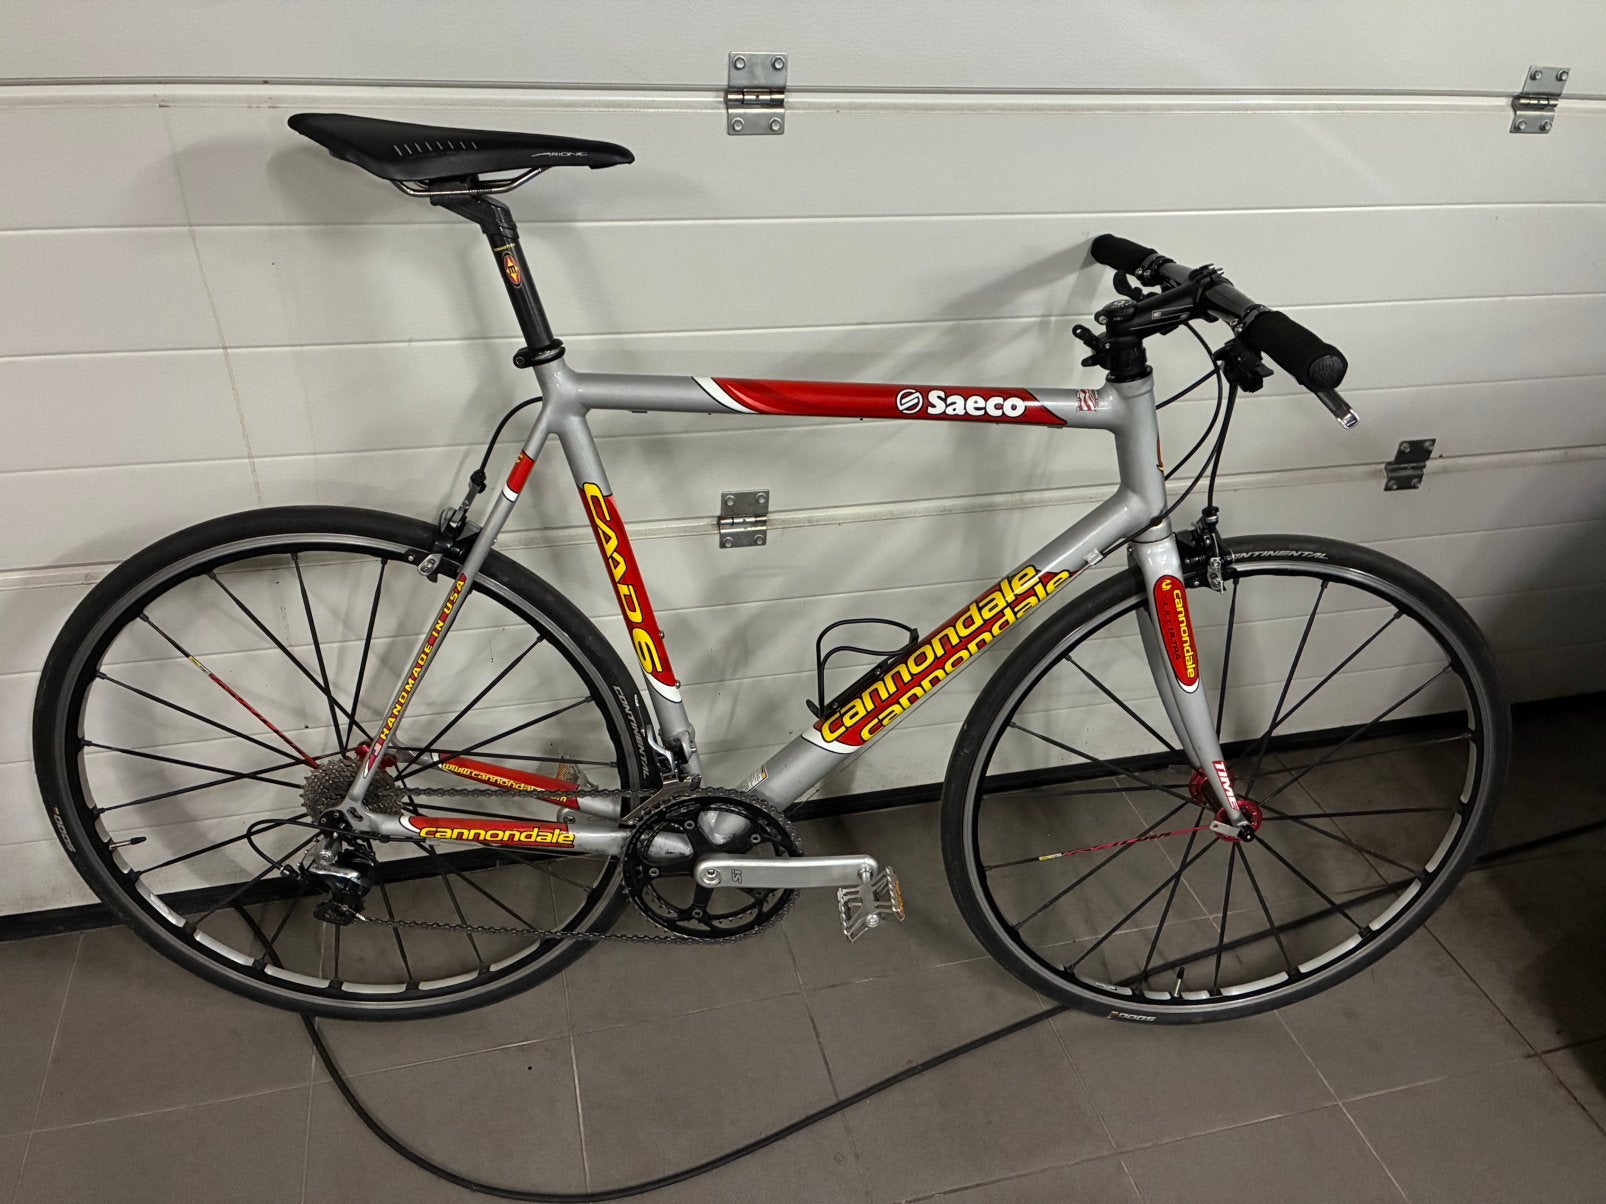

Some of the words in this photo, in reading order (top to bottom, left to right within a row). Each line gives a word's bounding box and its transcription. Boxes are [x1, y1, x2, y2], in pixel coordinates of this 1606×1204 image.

[927, 389, 1027, 418] Saeco
[1233, 550, 1328, 560] ONTINENTAL
[379, 642, 434, 740] HANDMADE
[431, 619, 444, 638] IN
[443, 579, 465, 615] USA
[821, 564, 1040, 742] cannondale
[860, 570, 1071, 742] cannondale
[1173, 590, 1196, 678] cannondale
[613, 685, 649, 779] CONTINENTAL
[1214, 761, 1240, 810] TIME
[419, 826, 576, 845] cannondale
